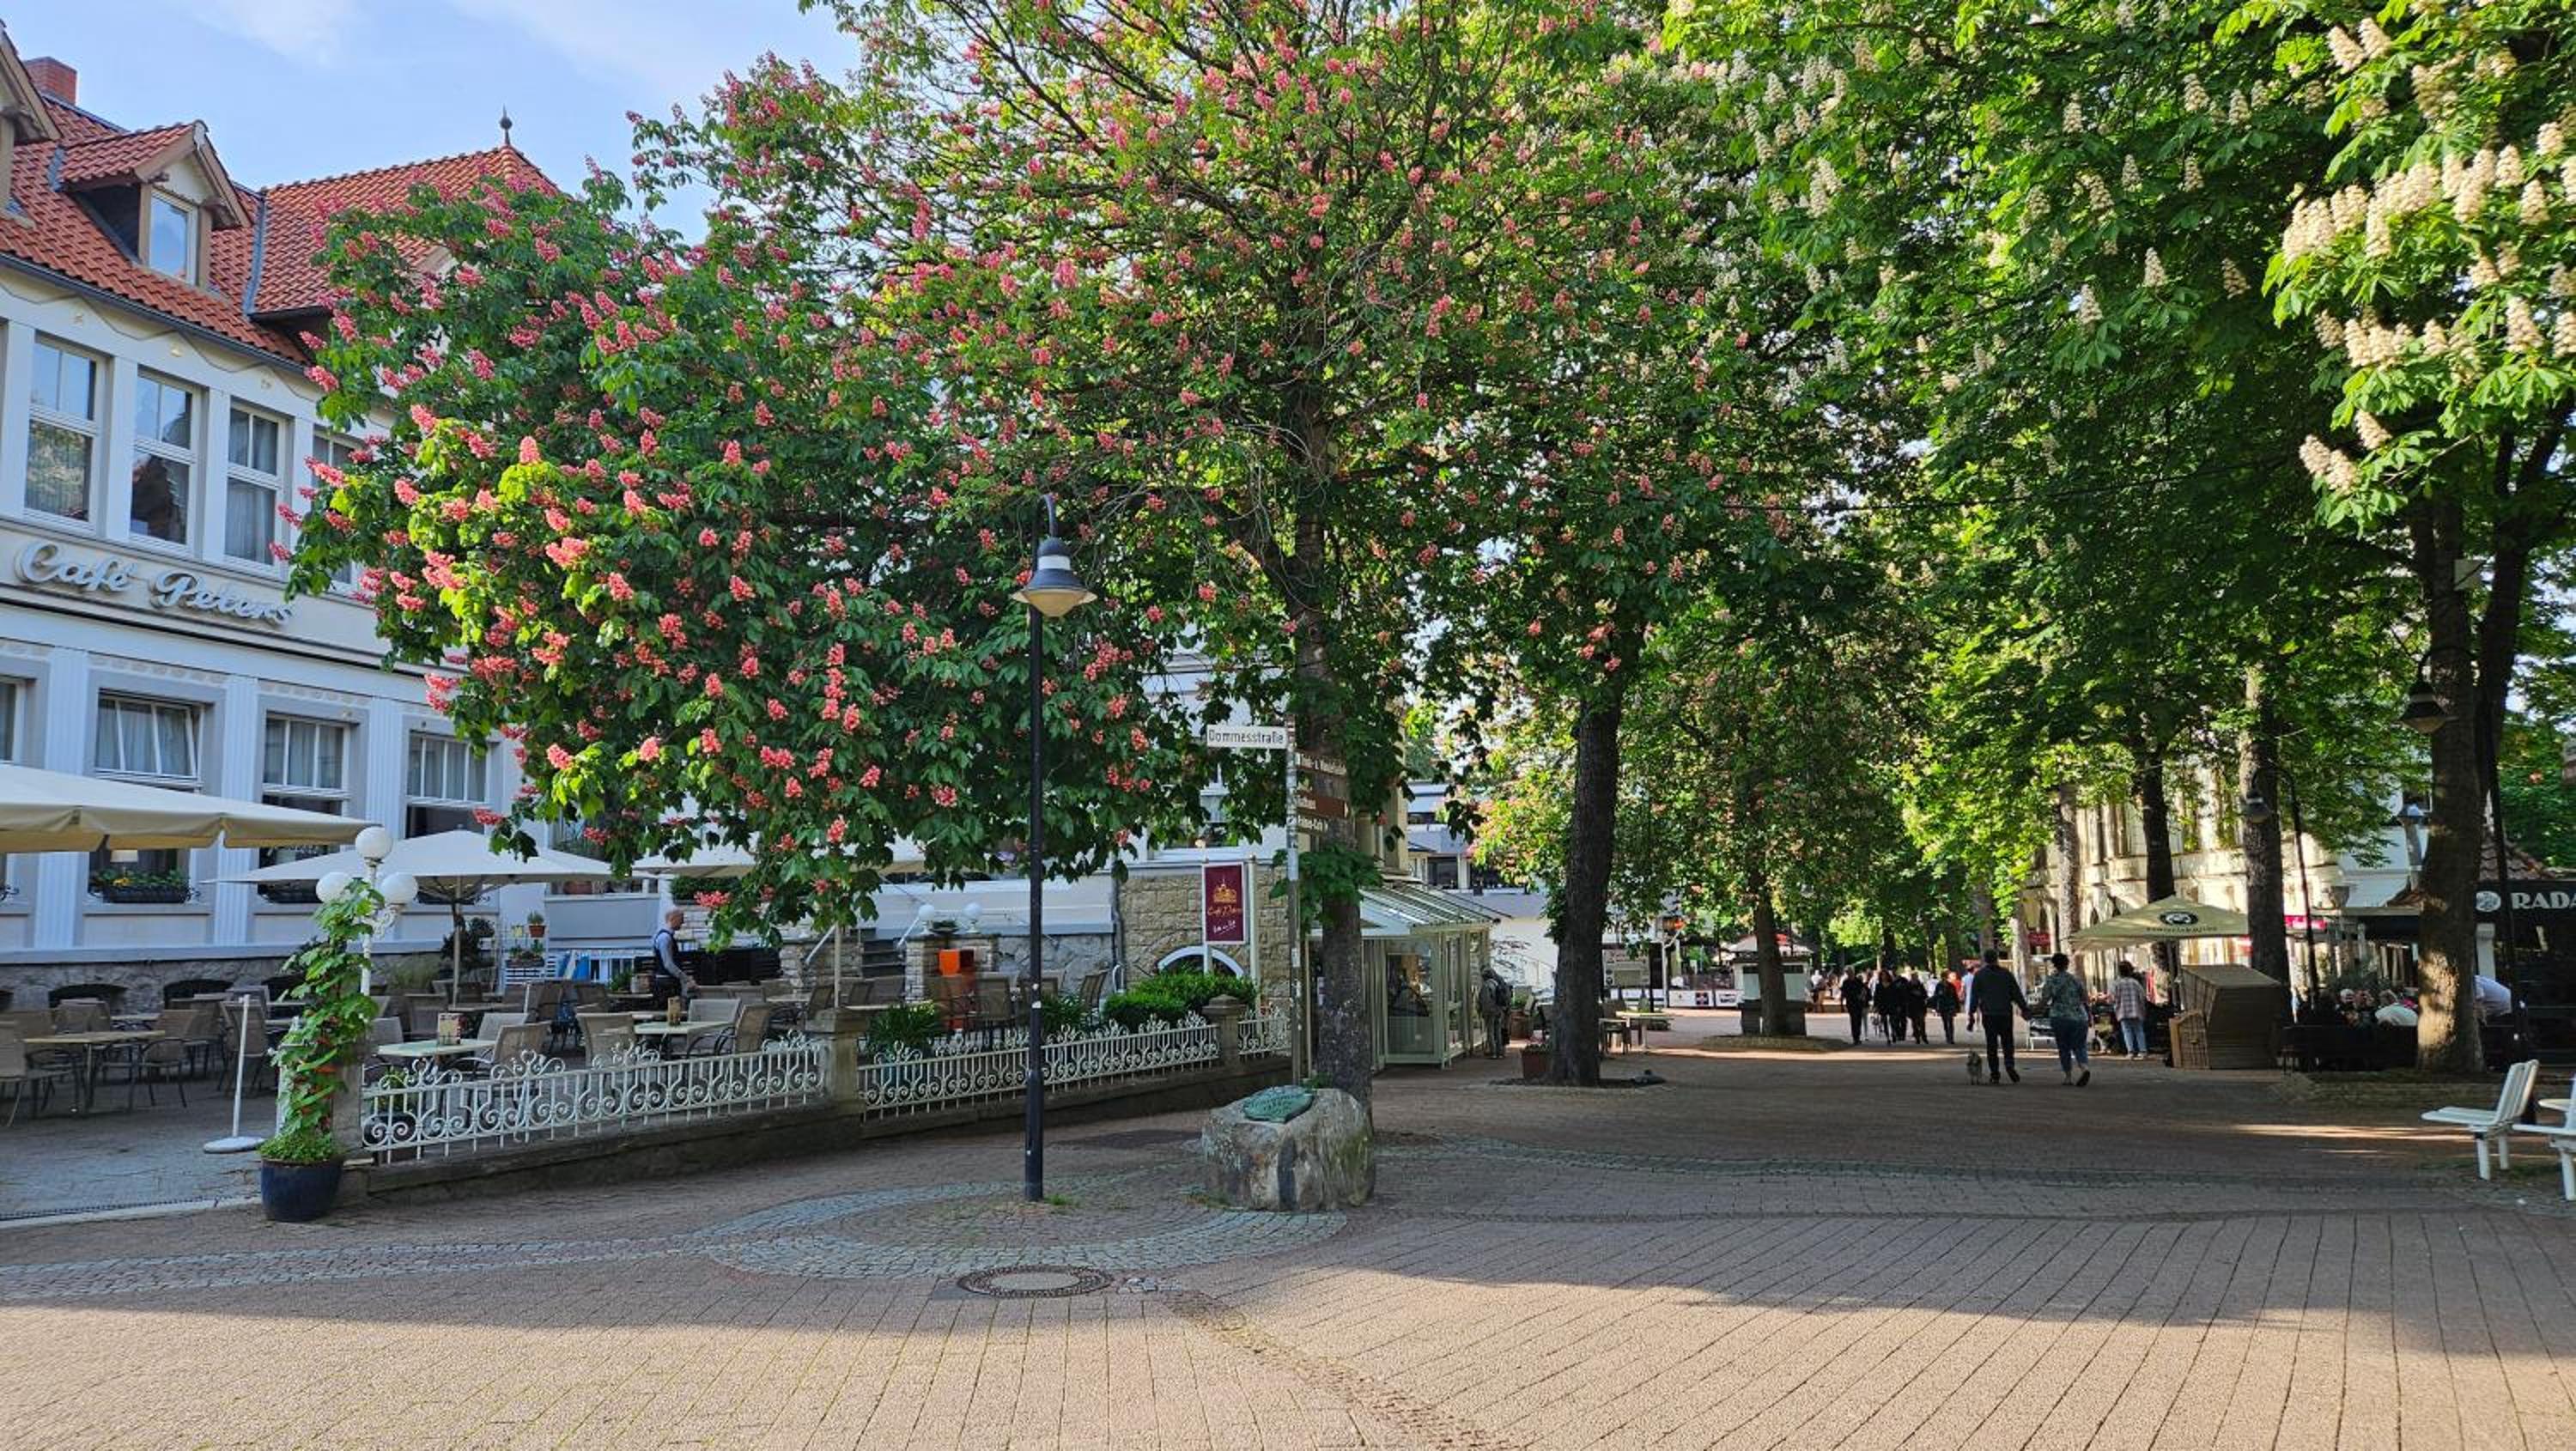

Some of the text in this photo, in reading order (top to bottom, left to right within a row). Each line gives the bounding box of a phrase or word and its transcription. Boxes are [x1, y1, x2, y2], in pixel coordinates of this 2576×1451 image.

[16, 541, 296, 627] Café Peters
[1208, 729, 1284, 744] Dommesstraße
